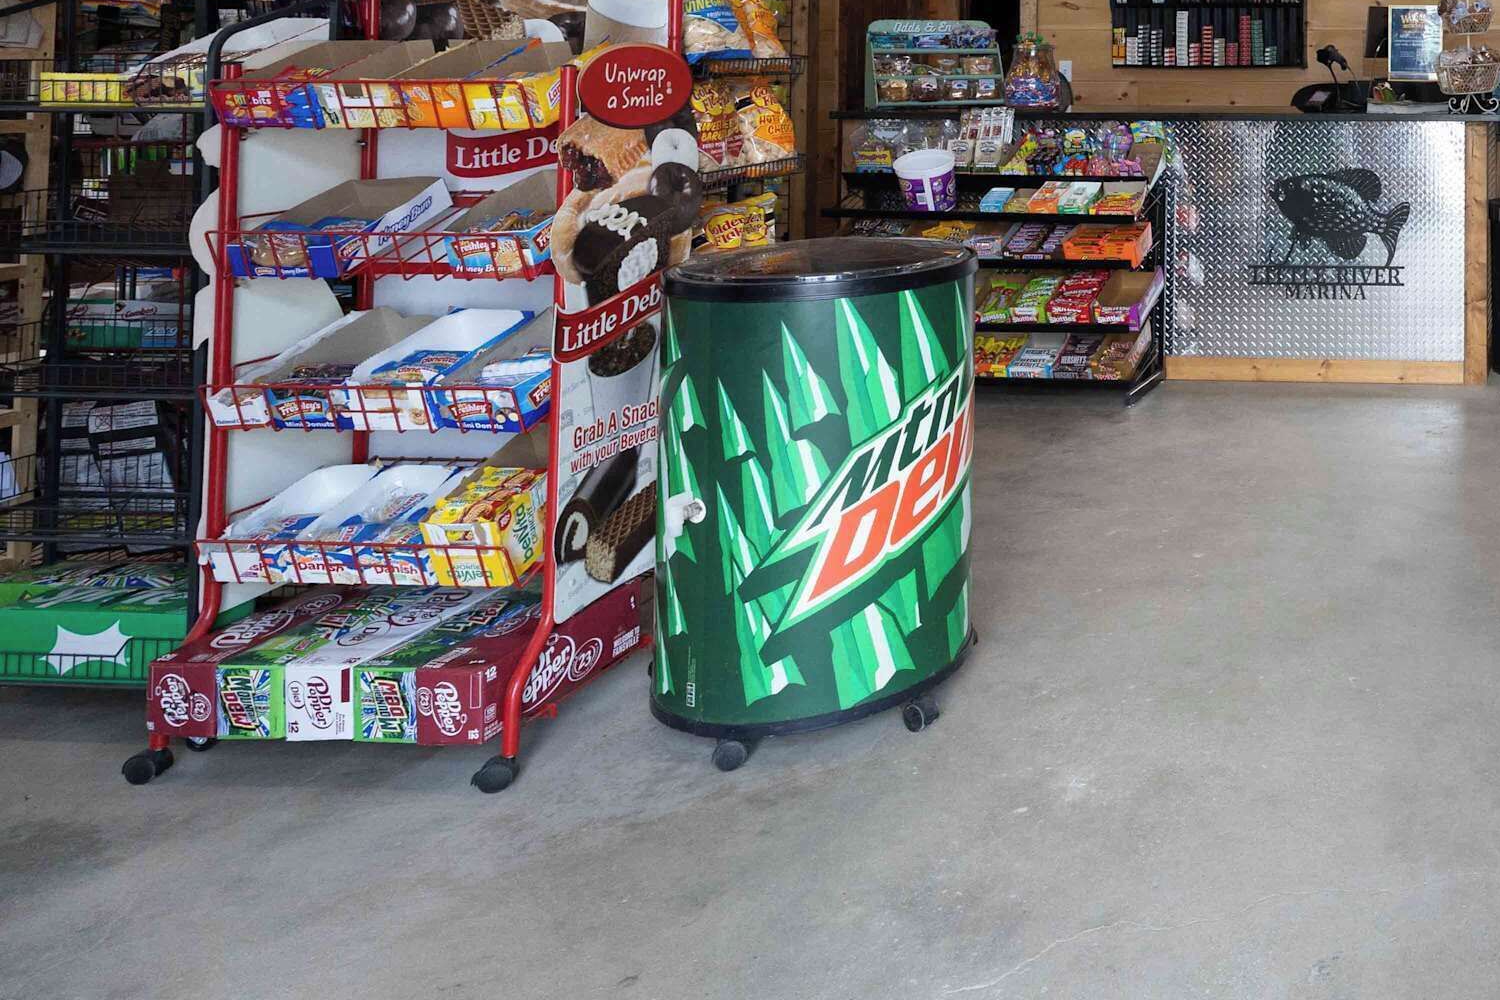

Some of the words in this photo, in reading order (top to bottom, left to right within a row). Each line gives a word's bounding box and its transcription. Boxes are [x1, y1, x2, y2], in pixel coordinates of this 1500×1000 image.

[892, 22, 920, 34] Odds
[938, 23, 953, 33] En
[604, 63, 667, 89] Unwrap
[251, 96, 272, 105] bits
[607, 96, 617, 110] a
[622, 85, 664, 110] Smile
[455, 143, 521, 169] Little
[1337, 267, 1401, 285] RIVER
[1285, 284, 1366, 300] MARINA
[561, 311, 617, 352] Little
[620, 285, 662, 326] Deb
[573, 416, 604, 449] Grab
[607, 411, 618, 435] A
[570, 449, 594, 474] with
[594, 439, 618, 465] your
[620, 424, 658, 451] Bevera
[512, 503, 535, 564] belVita
[484, 666, 497, 679] 12
[578, 650, 592, 671] 23
[522, 645, 571, 703] epper
[166, 678, 190, 721] Pepper
[290, 686, 302, 703] Diet
[306, 677, 330, 727] Pepper
[320, 694, 332, 714] Dr
[223, 692, 253, 726] DEW
[433, 687, 458, 732] Pepper
[448, 701, 461, 720] Dr
[292, 719, 300, 734] 12
